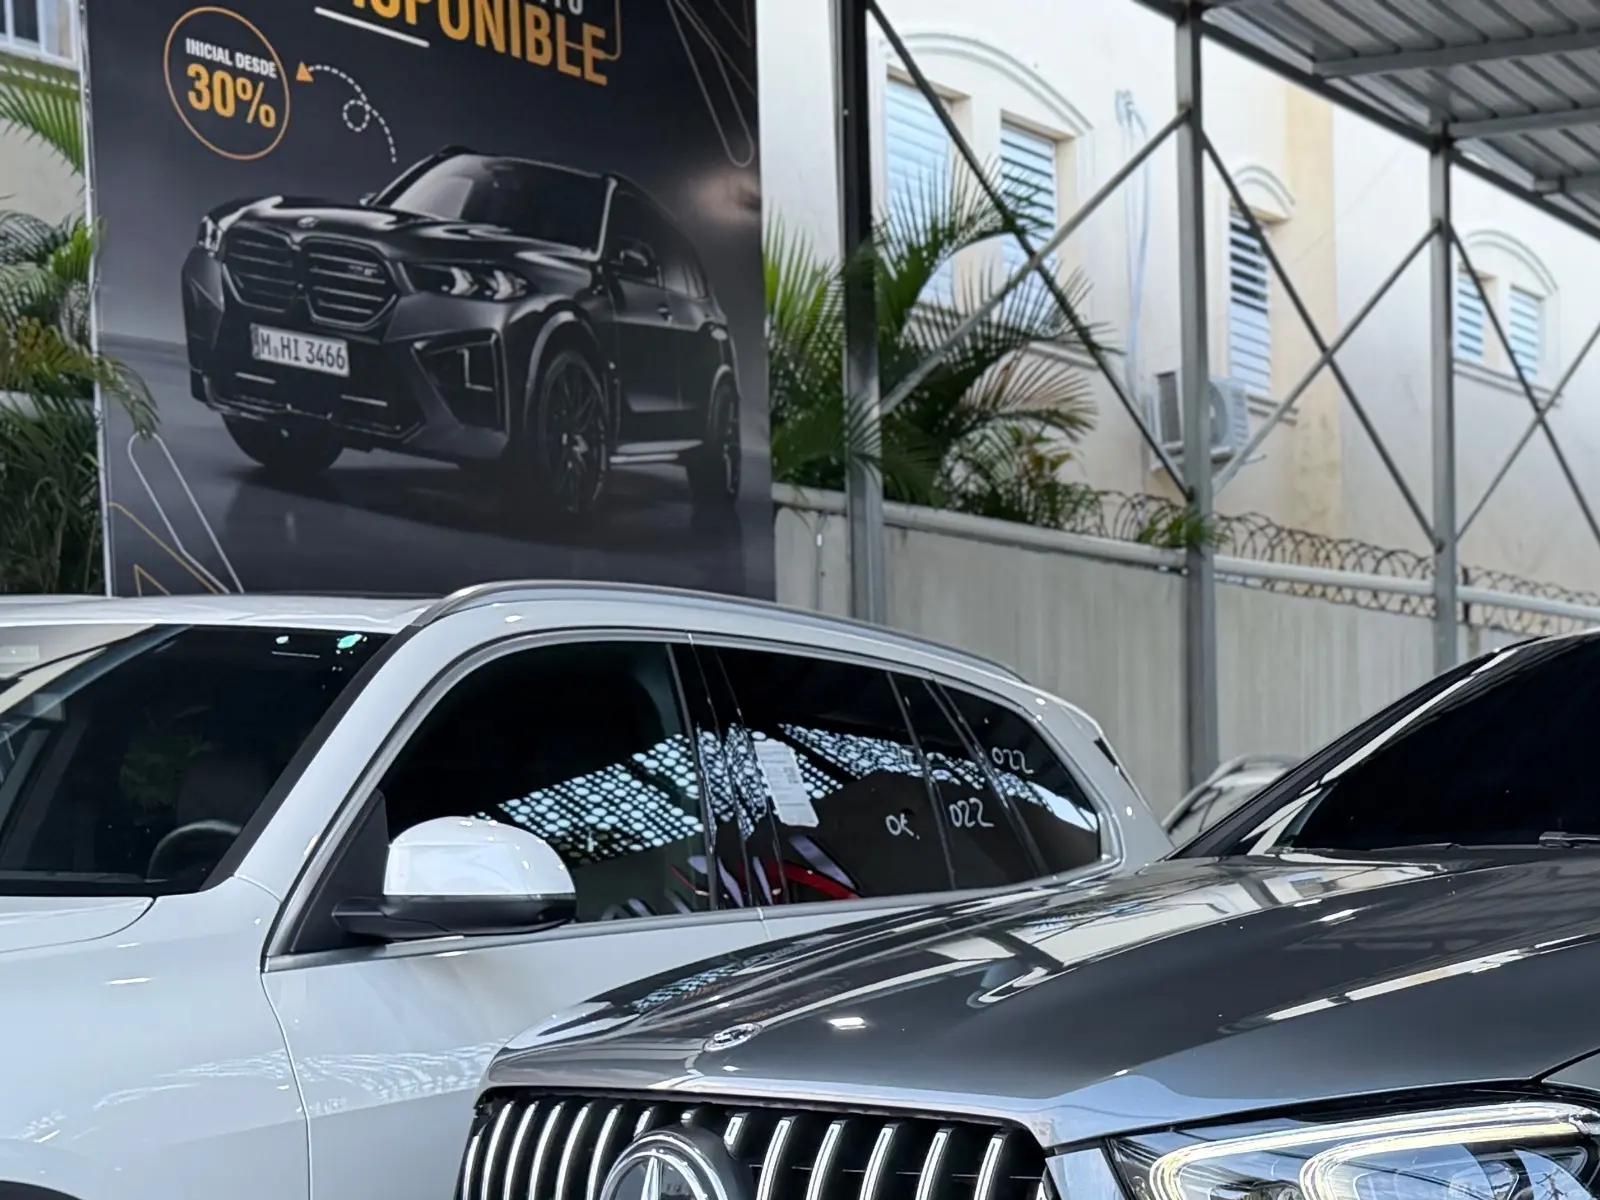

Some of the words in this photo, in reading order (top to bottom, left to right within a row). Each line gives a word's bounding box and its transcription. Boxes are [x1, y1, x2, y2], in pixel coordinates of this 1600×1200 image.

[185, 37, 234, 67] INICIAL
[235, 51, 278, 79] DESDE
[186, 63, 277, 128] 30%
[304, 340, 346, 371] 3466
